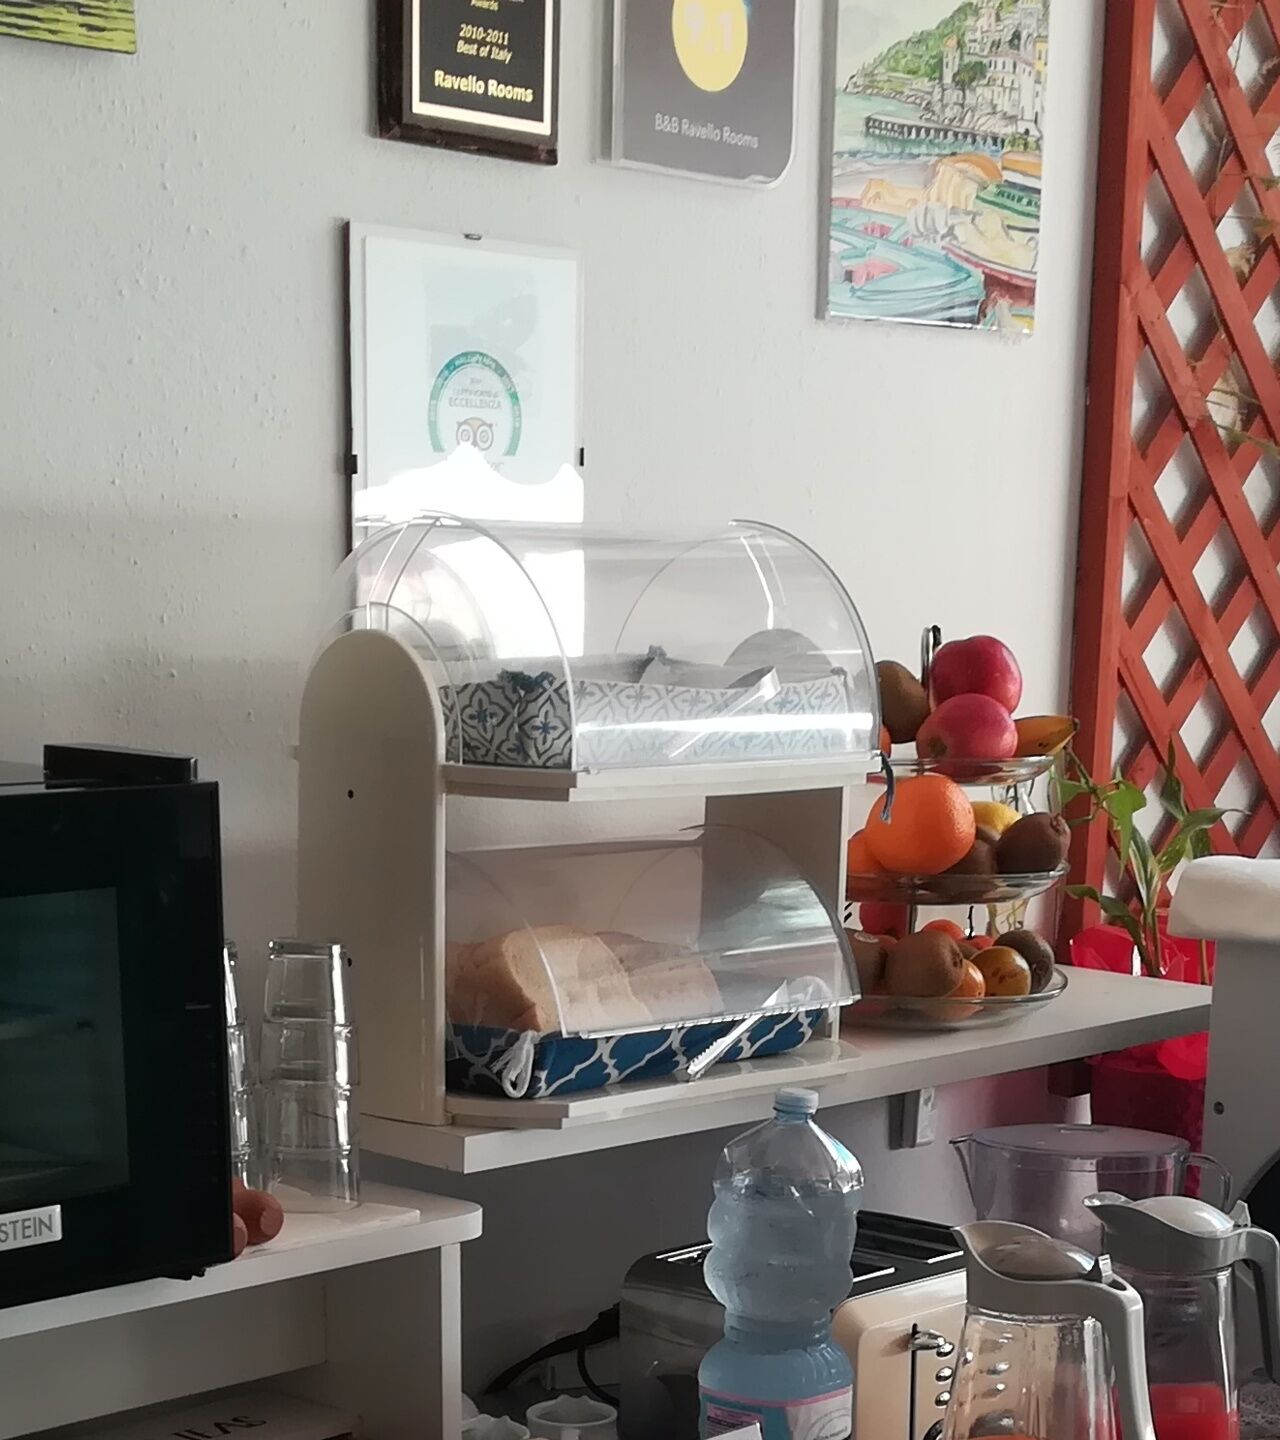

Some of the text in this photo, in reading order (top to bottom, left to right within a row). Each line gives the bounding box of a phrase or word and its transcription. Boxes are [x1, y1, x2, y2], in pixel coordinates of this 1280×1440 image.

[459, 23, 509, 46] 2010-2011
[456, 40, 513, 65] Best of Italy
[434, 69, 534, 103] Ravello Rooms
[655, 112, 759, 149] B&B Ravello Rooms
